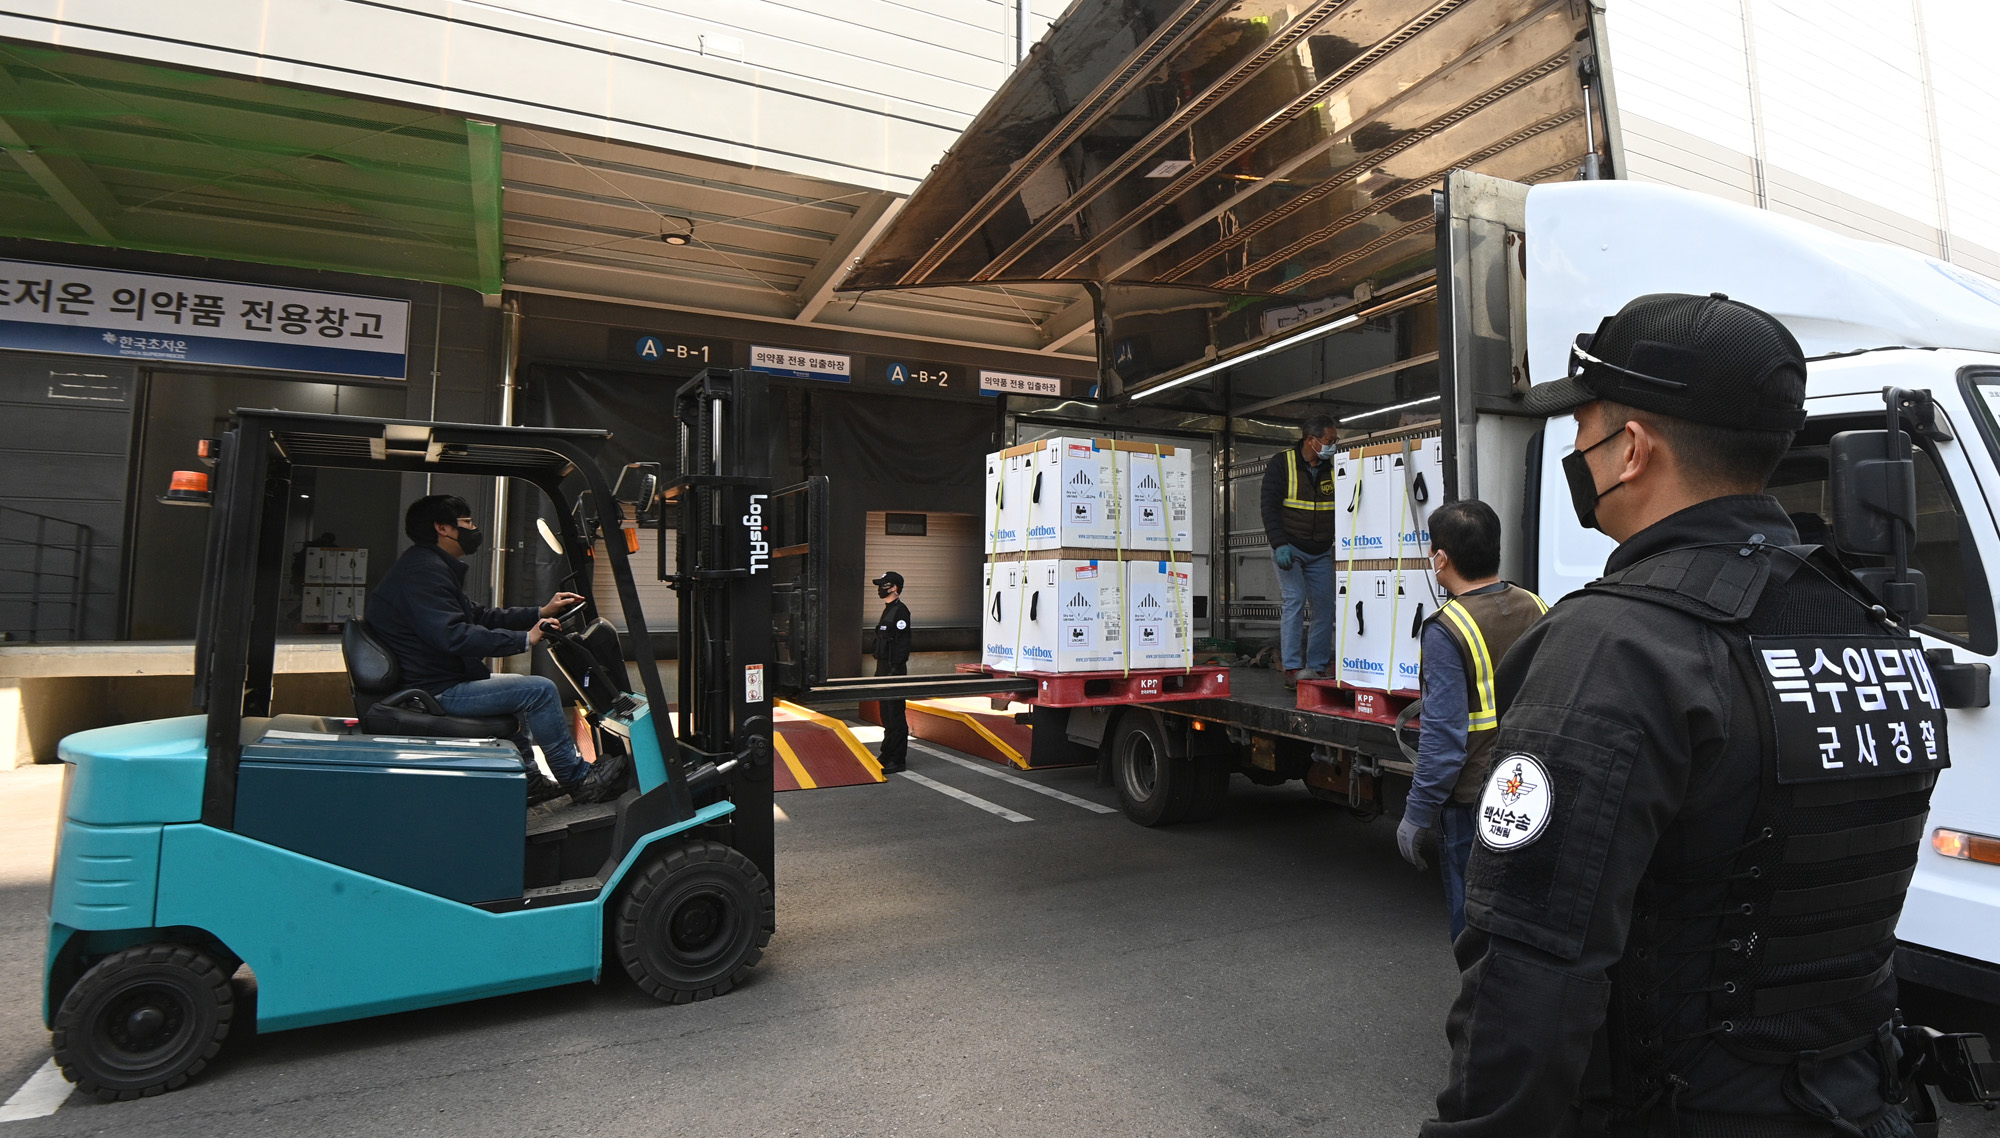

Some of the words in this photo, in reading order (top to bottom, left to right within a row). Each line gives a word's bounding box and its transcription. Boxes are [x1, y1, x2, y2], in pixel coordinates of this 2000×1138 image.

[109, 287, 226, 328] 의약품
[240, 300, 384, 340] 전용창고
[119, 336, 188, 353] 한국초저온
[756, 352, 785, 365] 의약품
[788, 356, 806, 367] 전용
[809, 358, 845, 371] 입출하장
[984, 377, 1008, 388] 의약품
[1010, 379, 1025, 390] 전용
[1027, 381, 1057, 393] 입출하장
[990, 528, 1016, 541] Sftbox
[987, 643, 1014, 656] Softbox
[1022, 645, 1053, 659] Softbox
[1342, 657, 1384, 672] Softbox
[1399, 662, 1420, 675] Sof
[1141, 679, 1158, 688] KPP
[1760, 647, 1941, 714] 특수임무대
[1357, 693, 1374, 703] KPP
[1816, 720, 1938, 769] 군사경찰
[1483, 805, 1531, 832] 백신수송
